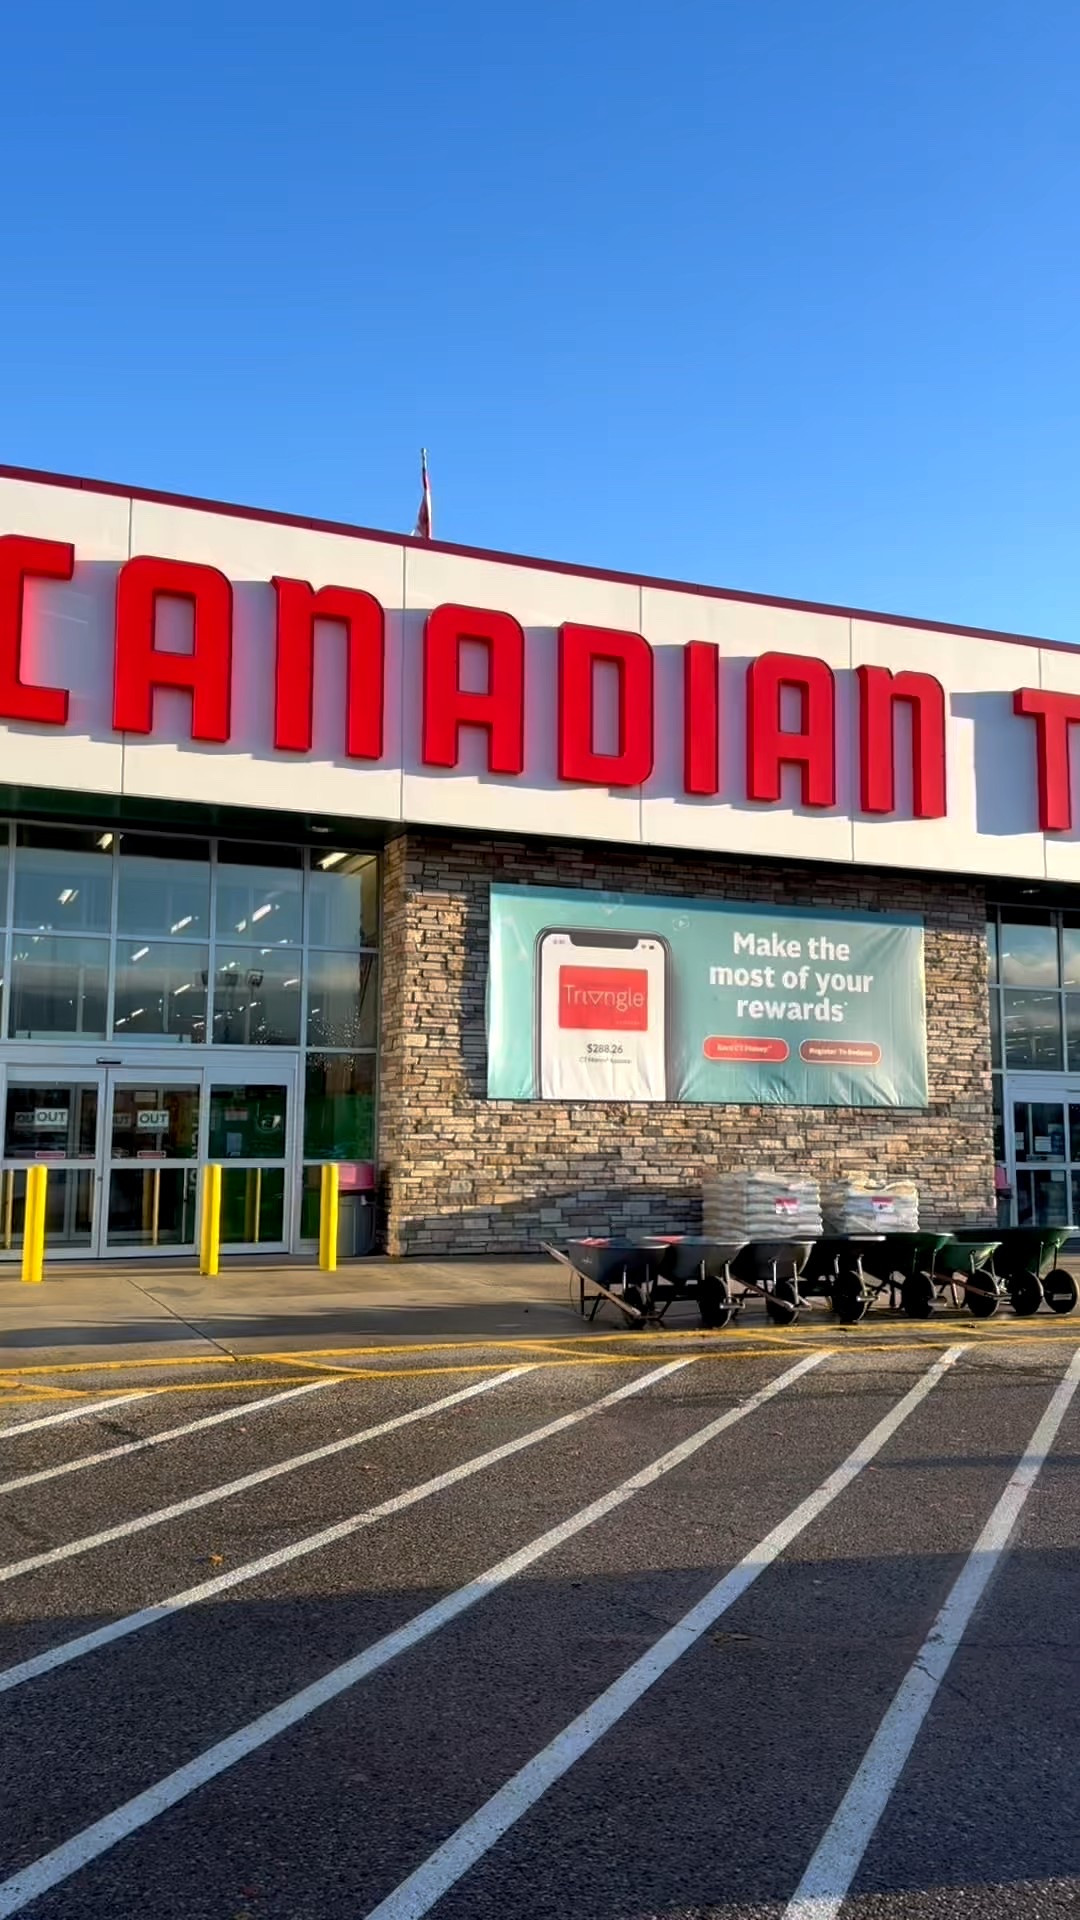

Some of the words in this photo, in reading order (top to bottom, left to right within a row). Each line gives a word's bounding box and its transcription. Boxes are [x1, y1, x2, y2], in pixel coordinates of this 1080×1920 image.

[0, 534, 947, 818] CANADIAN
[733, 931, 801, 958] Make
[807, 936, 850, 961] the
[709, 965, 776, 988] most
[782, 965, 810, 990] of
[815, 972, 873, 997] your
[586, 1043, 623, 1054] $288.26
[16, 1114, 34, 1123] OU
[37, 1111, 67, 1122] OUT
[139, 1113, 168, 1123] OUT
